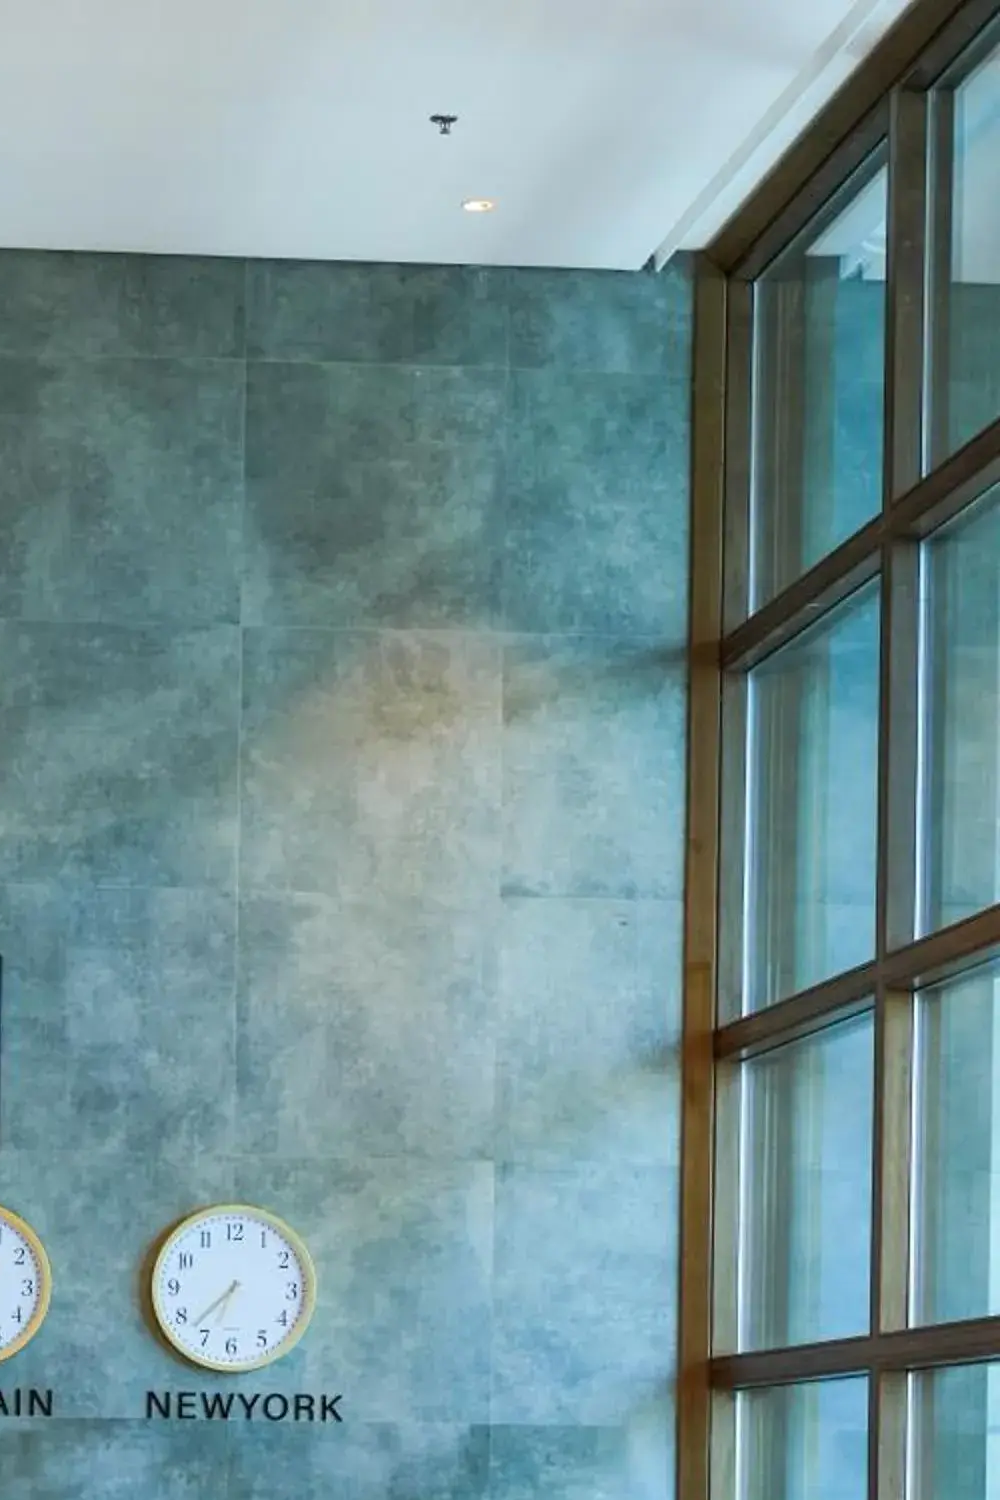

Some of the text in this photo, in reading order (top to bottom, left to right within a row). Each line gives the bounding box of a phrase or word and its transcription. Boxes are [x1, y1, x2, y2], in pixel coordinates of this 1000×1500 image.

[200, 1230, 211, 1249] 11
[226, 1223, 244, 1242] 12
[13, 1247, 26, 1266] 2
[178, 1252, 194, 1271] 10
[278, 1251, 290, 1269] 2
[20, 1279, 33, 1297] 3
[167, 1279, 181, 1296] 9
[285, 1282, 298, 1300] 3
[9, 1306, 22, 1324] 4
[175, 1307, 188, 1325] 8
[275, 1309, 288, 1327] 4
[199, 1329, 211, 1347] 7
[225, 1337, 238, 1354] 6
[256, 1329, 267, 1347] 5
[145, 1390, 343, 1423] NEWYORK
